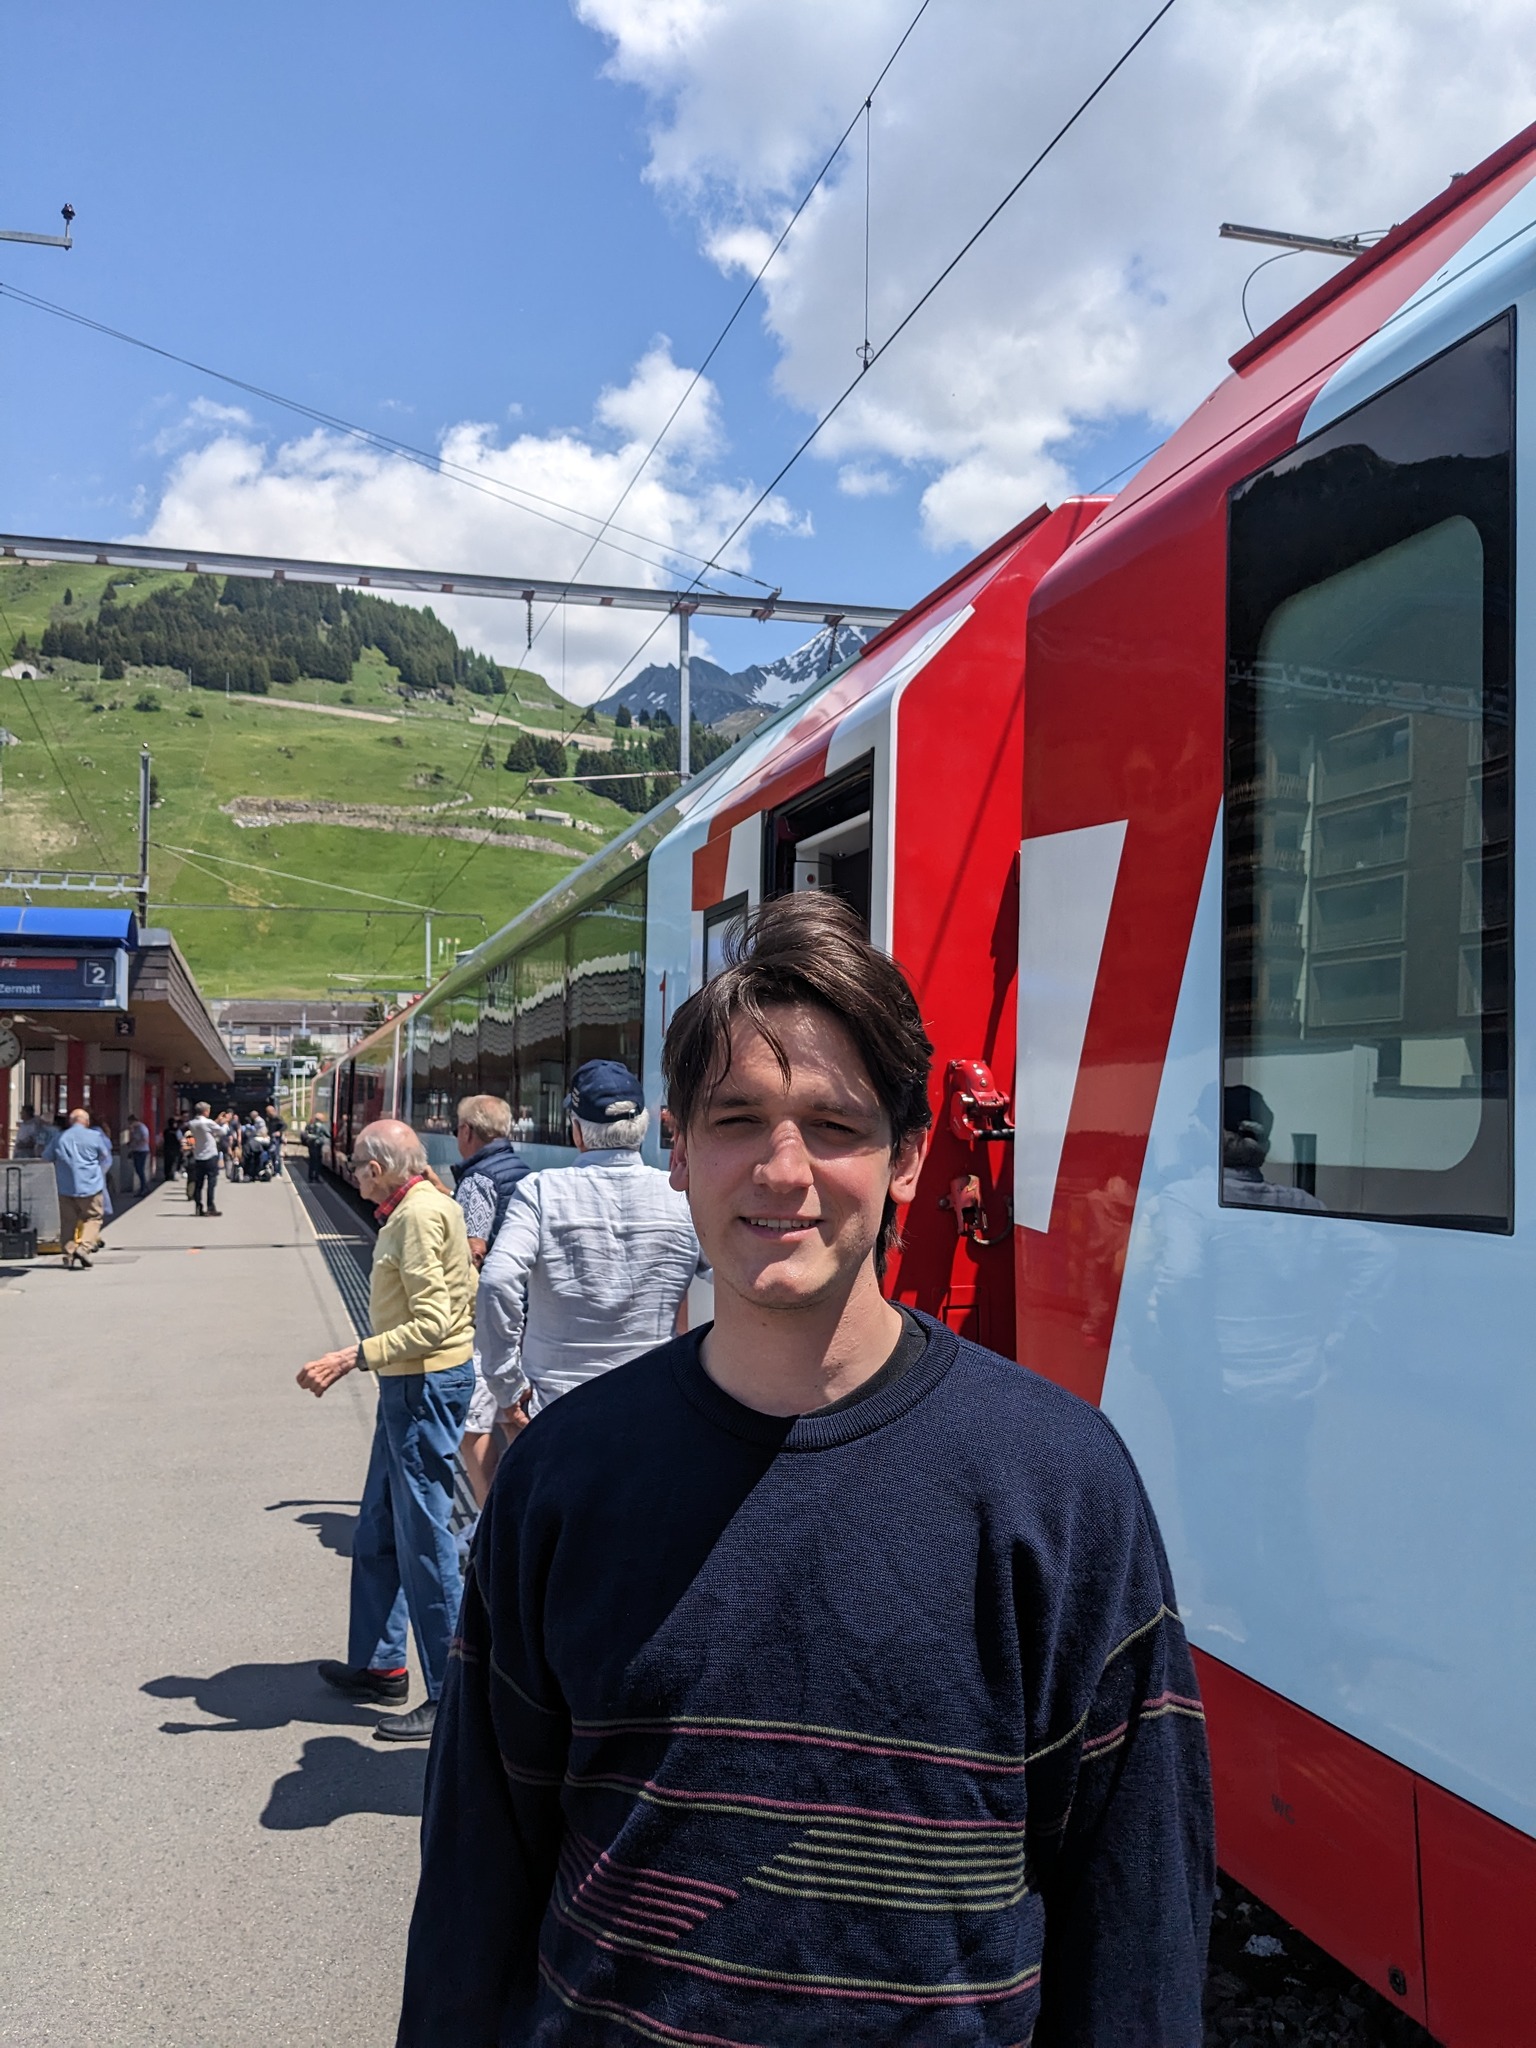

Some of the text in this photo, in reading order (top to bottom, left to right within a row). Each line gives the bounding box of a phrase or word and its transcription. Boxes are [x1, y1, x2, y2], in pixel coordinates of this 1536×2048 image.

[92, 967, 106, 984] 2
[0, 984, 41, 994] Zermatt
[120, 1023, 129, 1033] 2
[1272, 1793, 1295, 1824] WC
